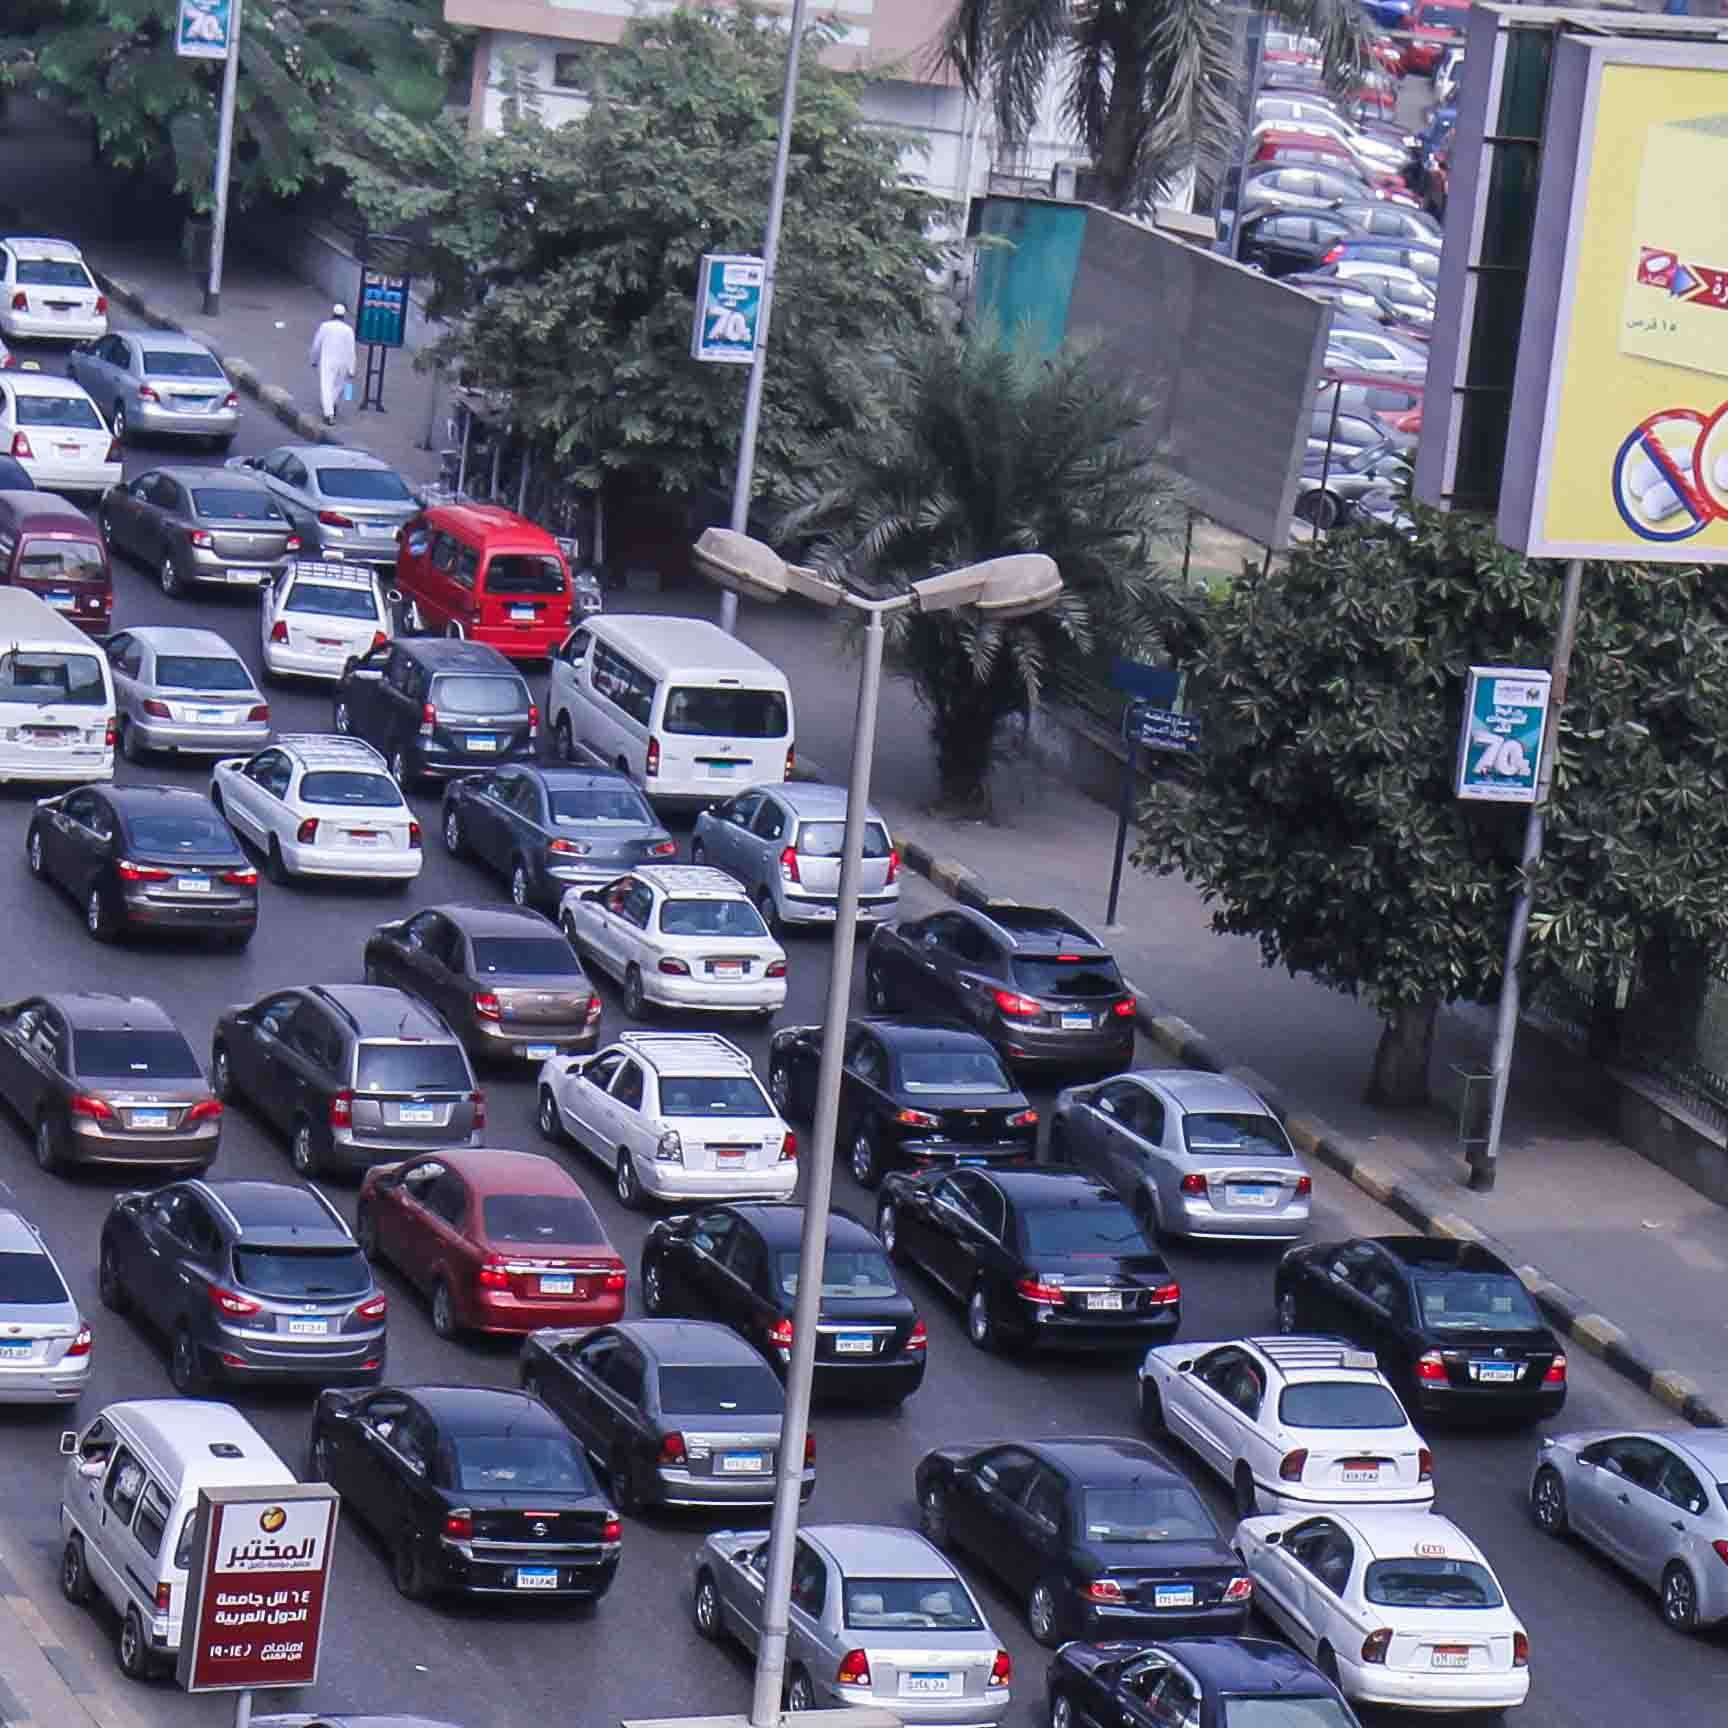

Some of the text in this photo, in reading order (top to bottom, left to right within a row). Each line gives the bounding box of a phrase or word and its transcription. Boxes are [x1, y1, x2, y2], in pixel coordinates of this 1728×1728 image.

[226, 1538, 316, 1568] المختبر
[216, 1592, 264, 1607] جامعة
[215, 1609, 308, 1626] الدول العربية
